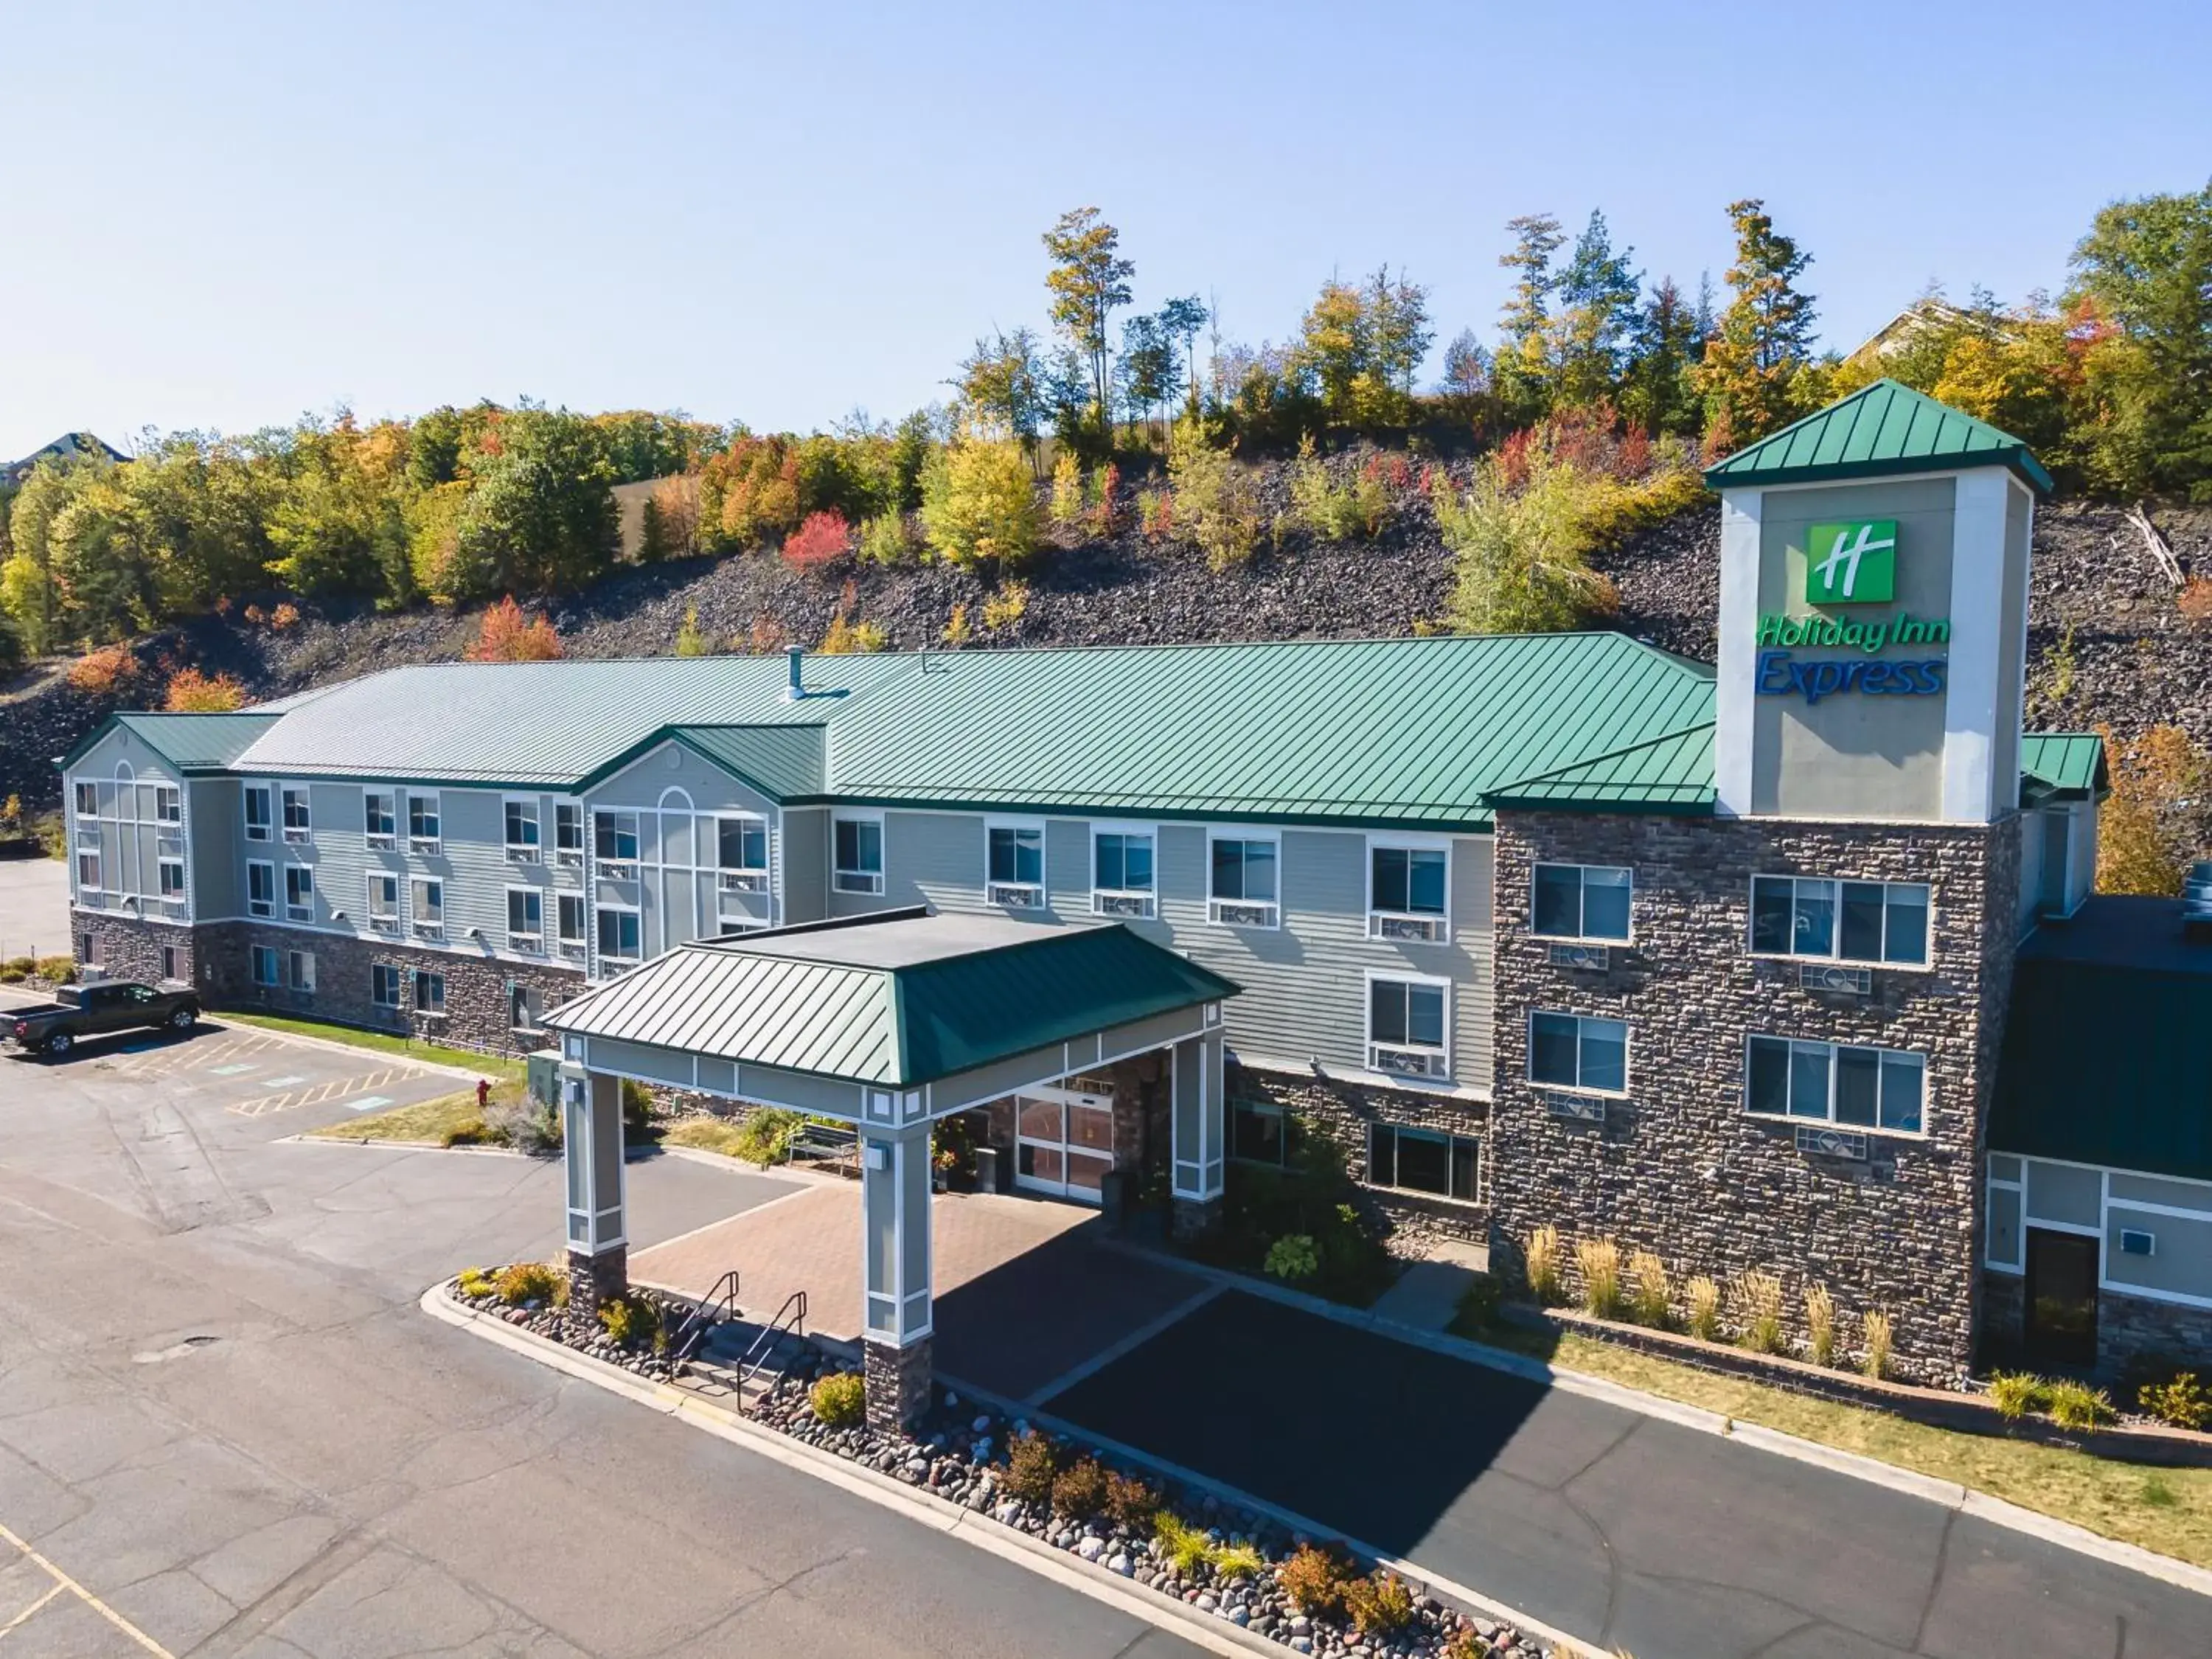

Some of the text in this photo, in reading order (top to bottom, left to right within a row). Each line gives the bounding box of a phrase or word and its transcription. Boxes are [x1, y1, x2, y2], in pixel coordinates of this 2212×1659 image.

[1815, 524, 1894, 597] H
[1756, 613, 1950, 653] Holiday Inn
[1755, 652, 1945, 704] Express
